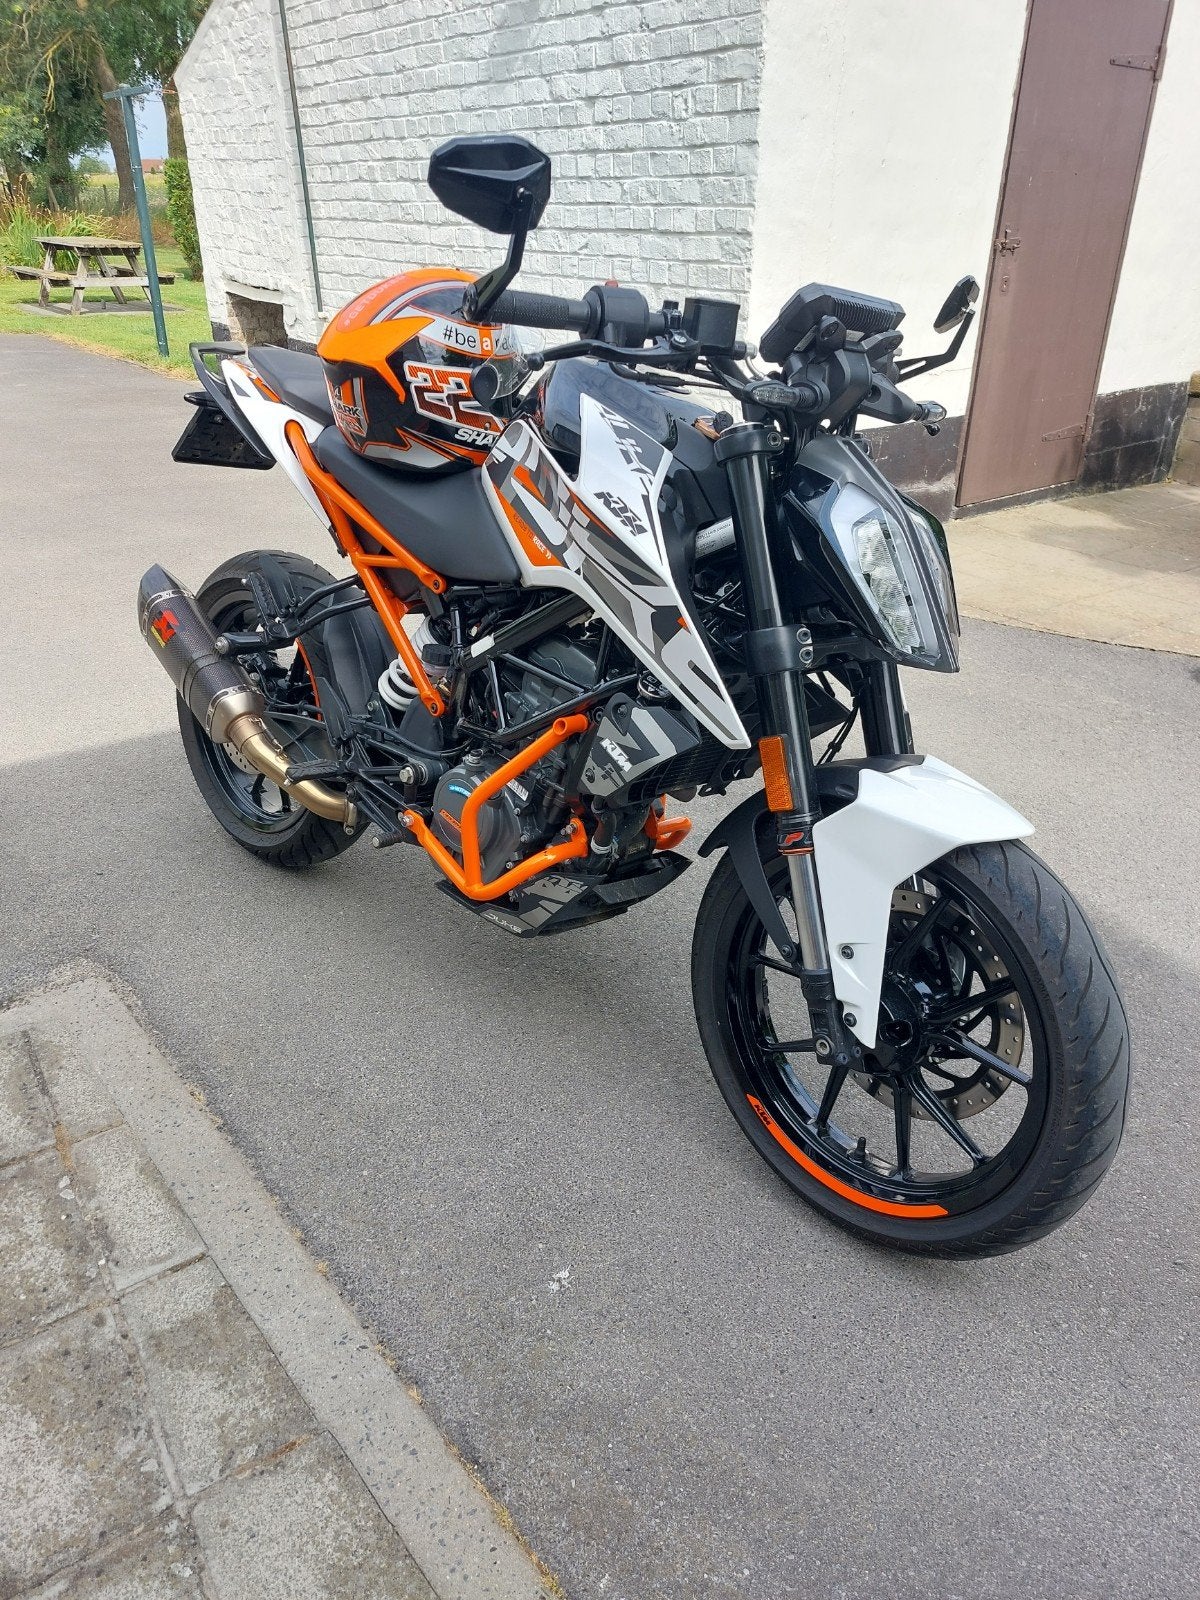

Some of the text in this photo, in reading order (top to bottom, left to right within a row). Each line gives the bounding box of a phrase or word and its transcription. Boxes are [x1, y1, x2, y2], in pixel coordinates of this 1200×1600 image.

[403, 360, 504, 435] 22
[454, 427, 500, 446] SHA
[593, 491, 648, 537] KTM
[601, 738, 633, 772] KTM
[754, 1104, 771, 1126] KTM
